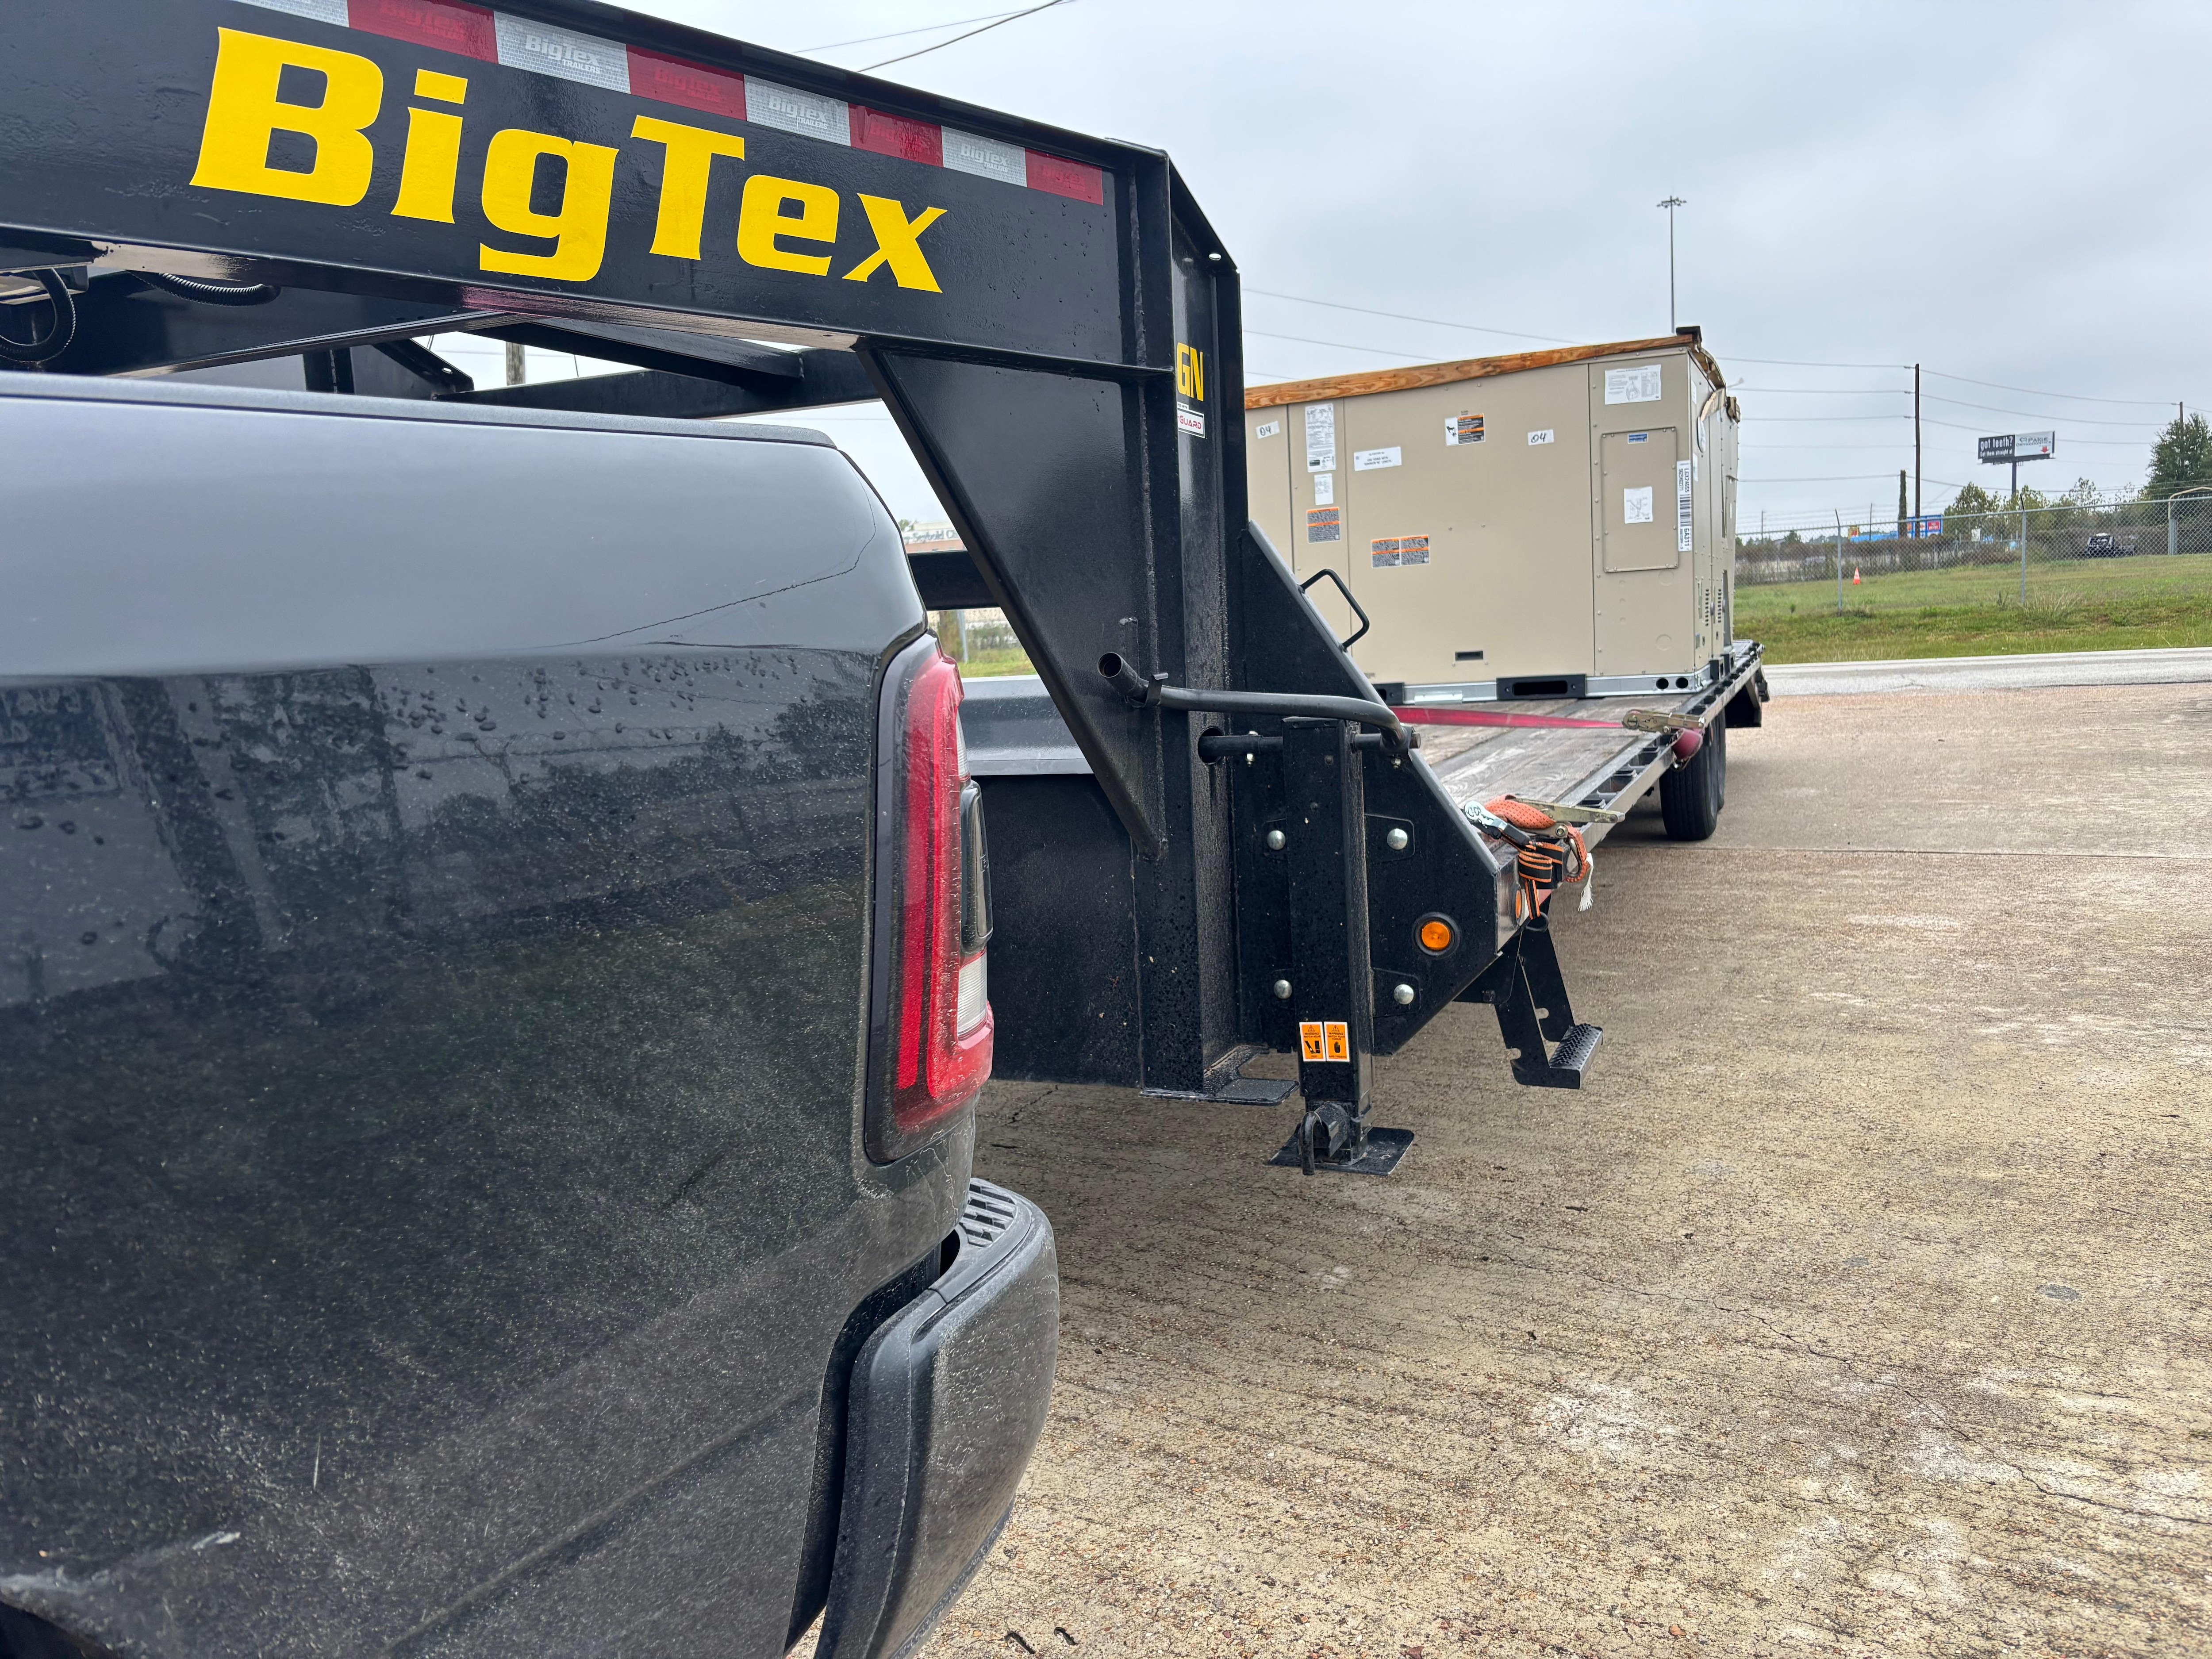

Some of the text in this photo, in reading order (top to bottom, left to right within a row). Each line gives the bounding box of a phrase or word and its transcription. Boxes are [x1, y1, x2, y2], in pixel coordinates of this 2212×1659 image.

[526, 35, 600, 66] BigTex
[562, 58, 600, 74] TRAILERS
[769, 95, 827, 123] BigTex
[798, 116, 827, 129] TRAILERS
[190, 27, 946, 293] BigTex
[960, 143, 1007, 167] BigTex
[1177, 342, 1204, 402] GN
[1260, 426, 1271, 436] 04
[1531, 433, 1547, 443] 04
[1980, 436, 2013, 451] got teeth?
